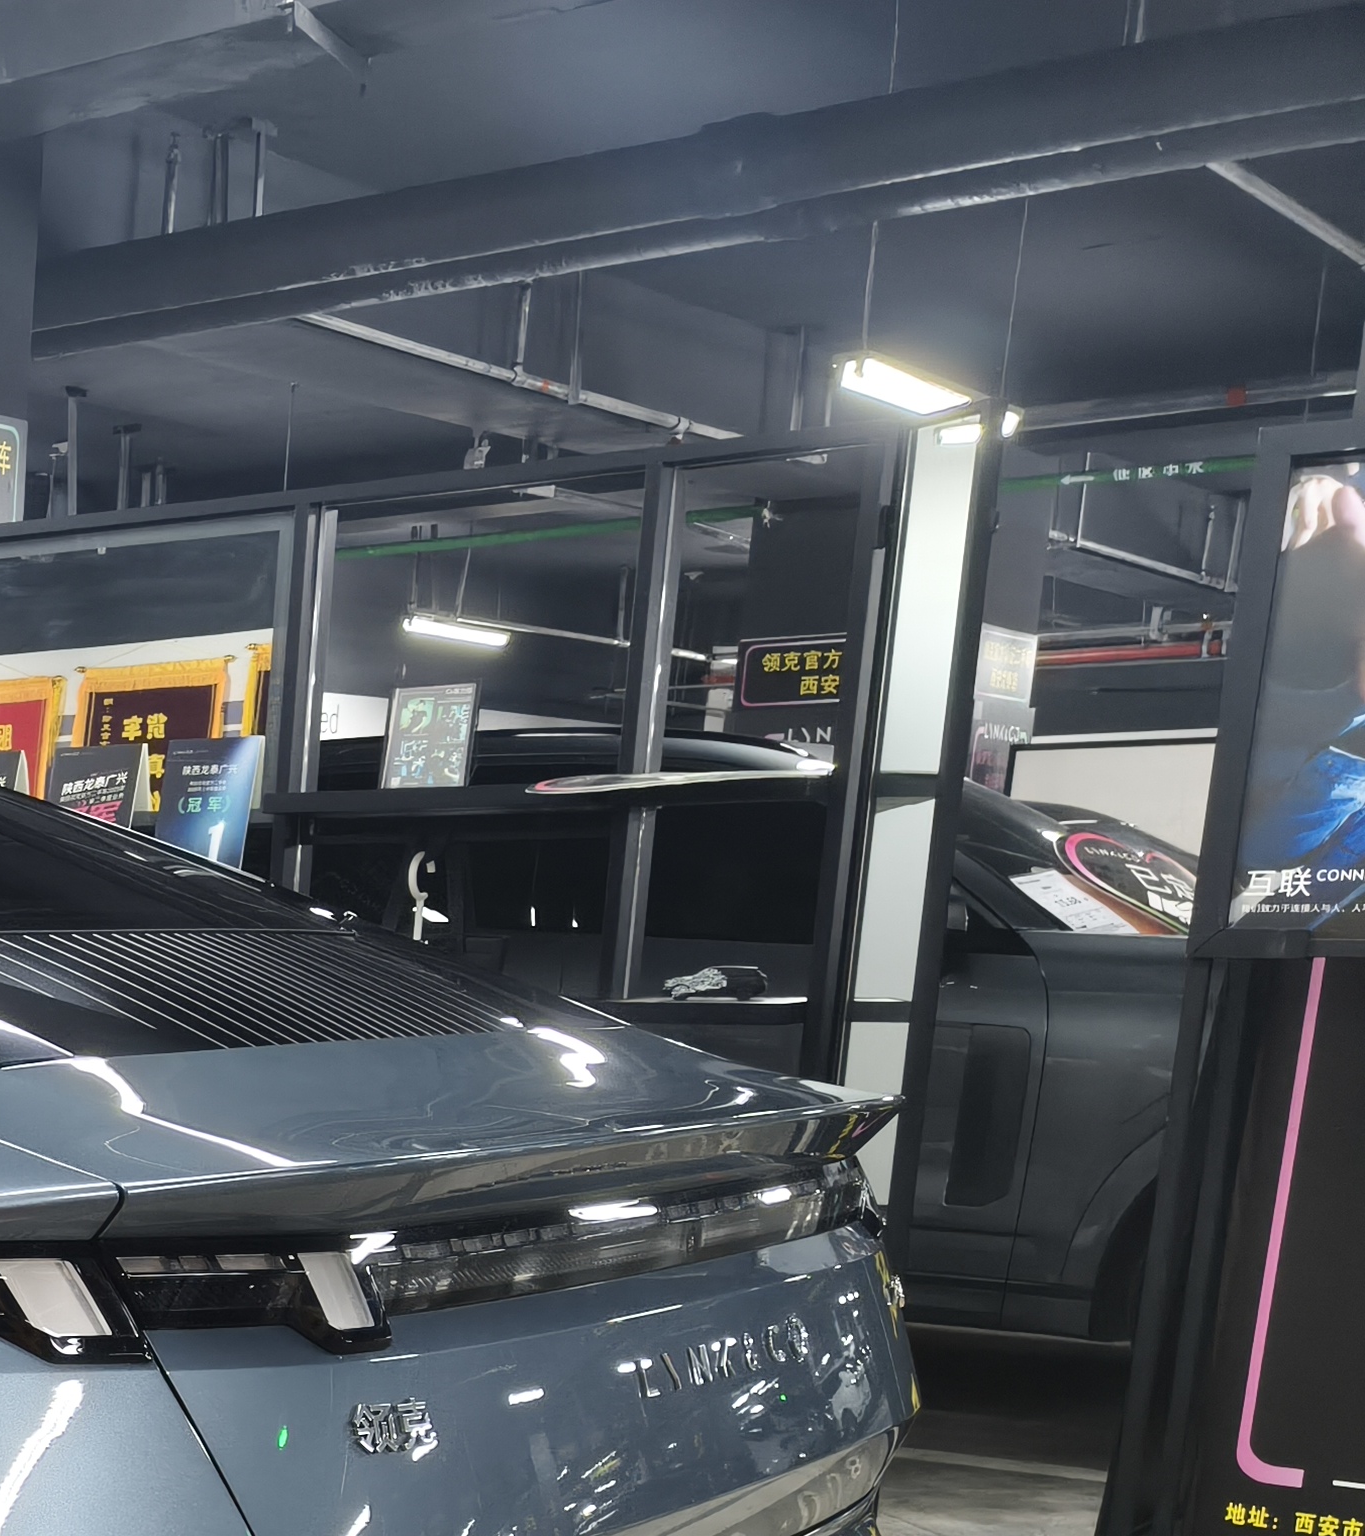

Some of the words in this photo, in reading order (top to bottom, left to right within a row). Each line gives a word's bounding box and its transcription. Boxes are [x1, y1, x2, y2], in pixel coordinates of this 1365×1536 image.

[761, 649, 843, 673] 领克官方
[799, 674, 841, 696] 西安
[1242, 867, 1313, 898] 互联
[353, 1396, 437, 1455] 领克
